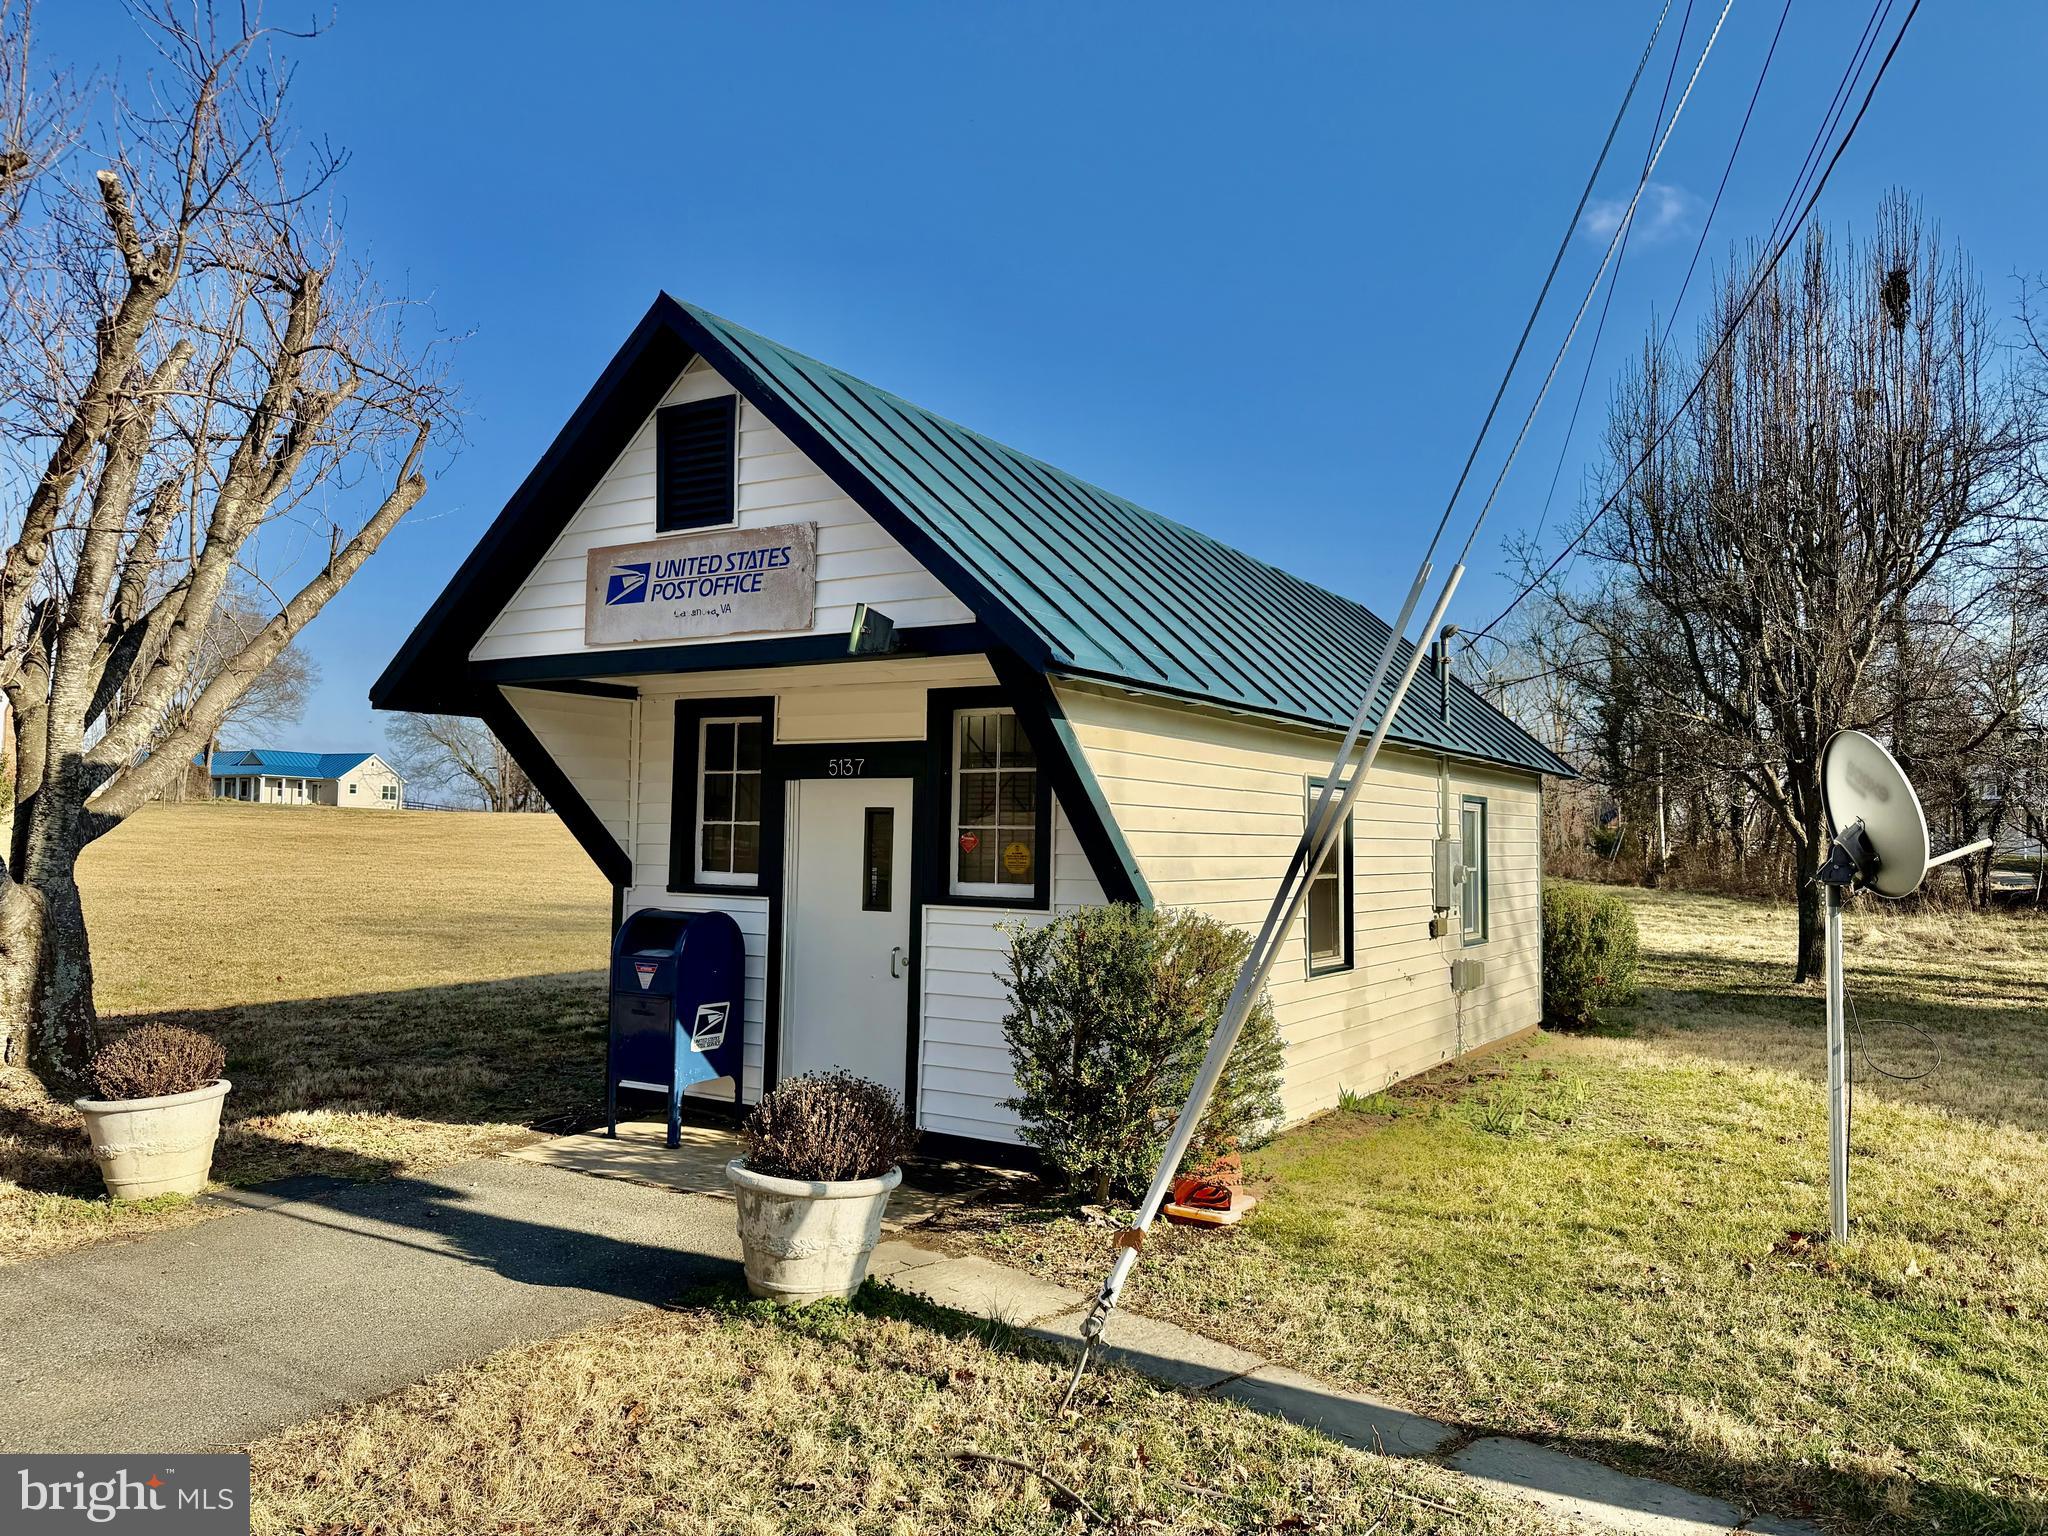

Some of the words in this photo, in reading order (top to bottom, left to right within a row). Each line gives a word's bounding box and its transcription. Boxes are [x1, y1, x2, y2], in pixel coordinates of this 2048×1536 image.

[656, 555, 722, 578] UNITED
[725, 546, 791, 572] STATES
[651, 580, 698, 601] POST
[699, 573, 764, 597] OFFICE
[720, 603, 732, 614] VA
[828, 758, 865, 776] 5137
